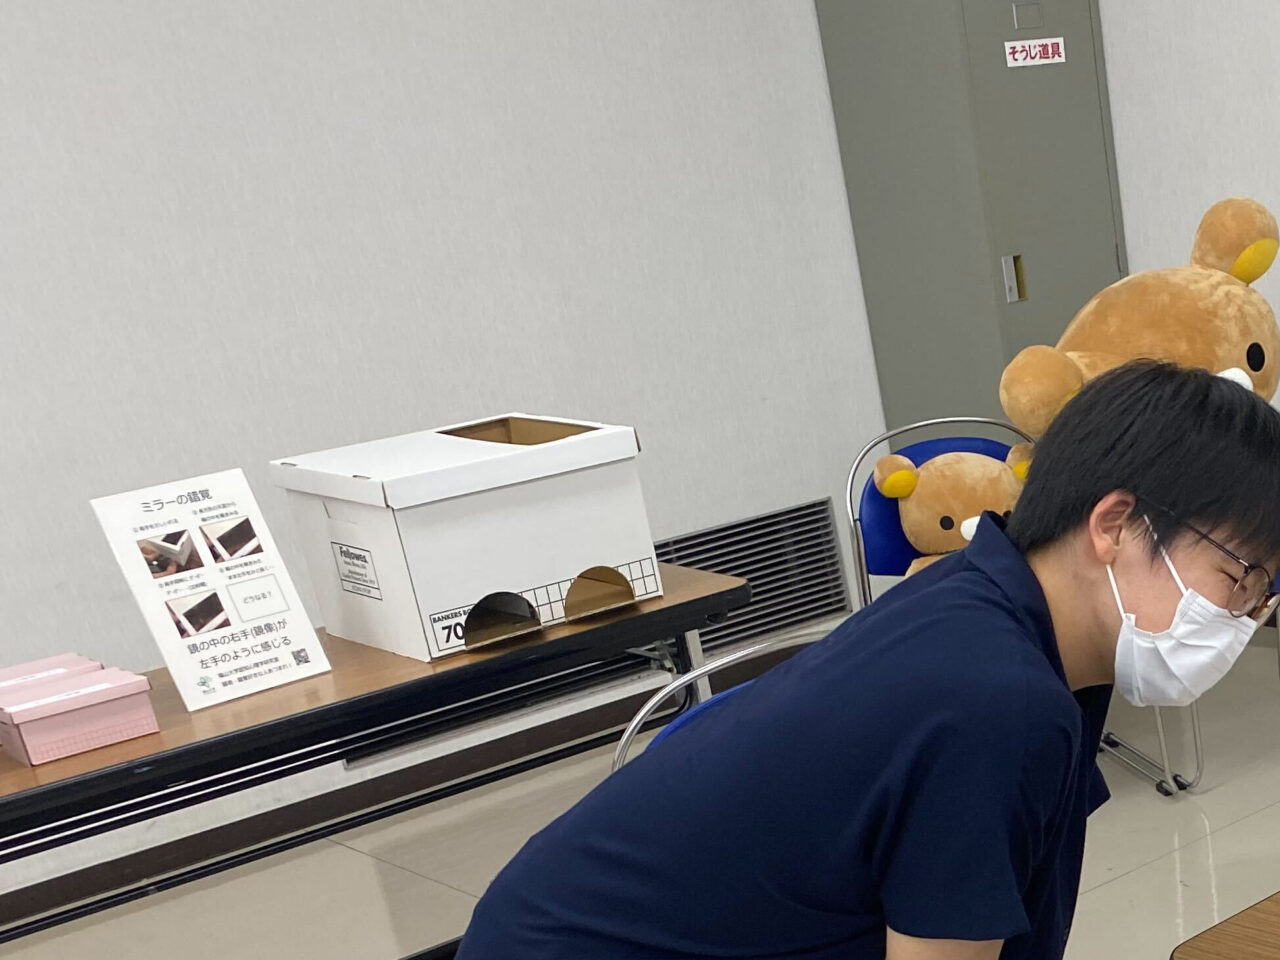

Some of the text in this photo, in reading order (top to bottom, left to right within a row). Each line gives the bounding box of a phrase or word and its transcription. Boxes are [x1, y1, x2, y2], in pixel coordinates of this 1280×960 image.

[1009, 42, 1062, 61] そうじ道具
[140, 489, 213, 512] ミラーの錯覚
[432, 610, 462, 623] BANKERS
[187, 619, 288, 655] 鏡の中の右手(鏡像)が
[200, 636, 292, 670] 左手のように感じる
